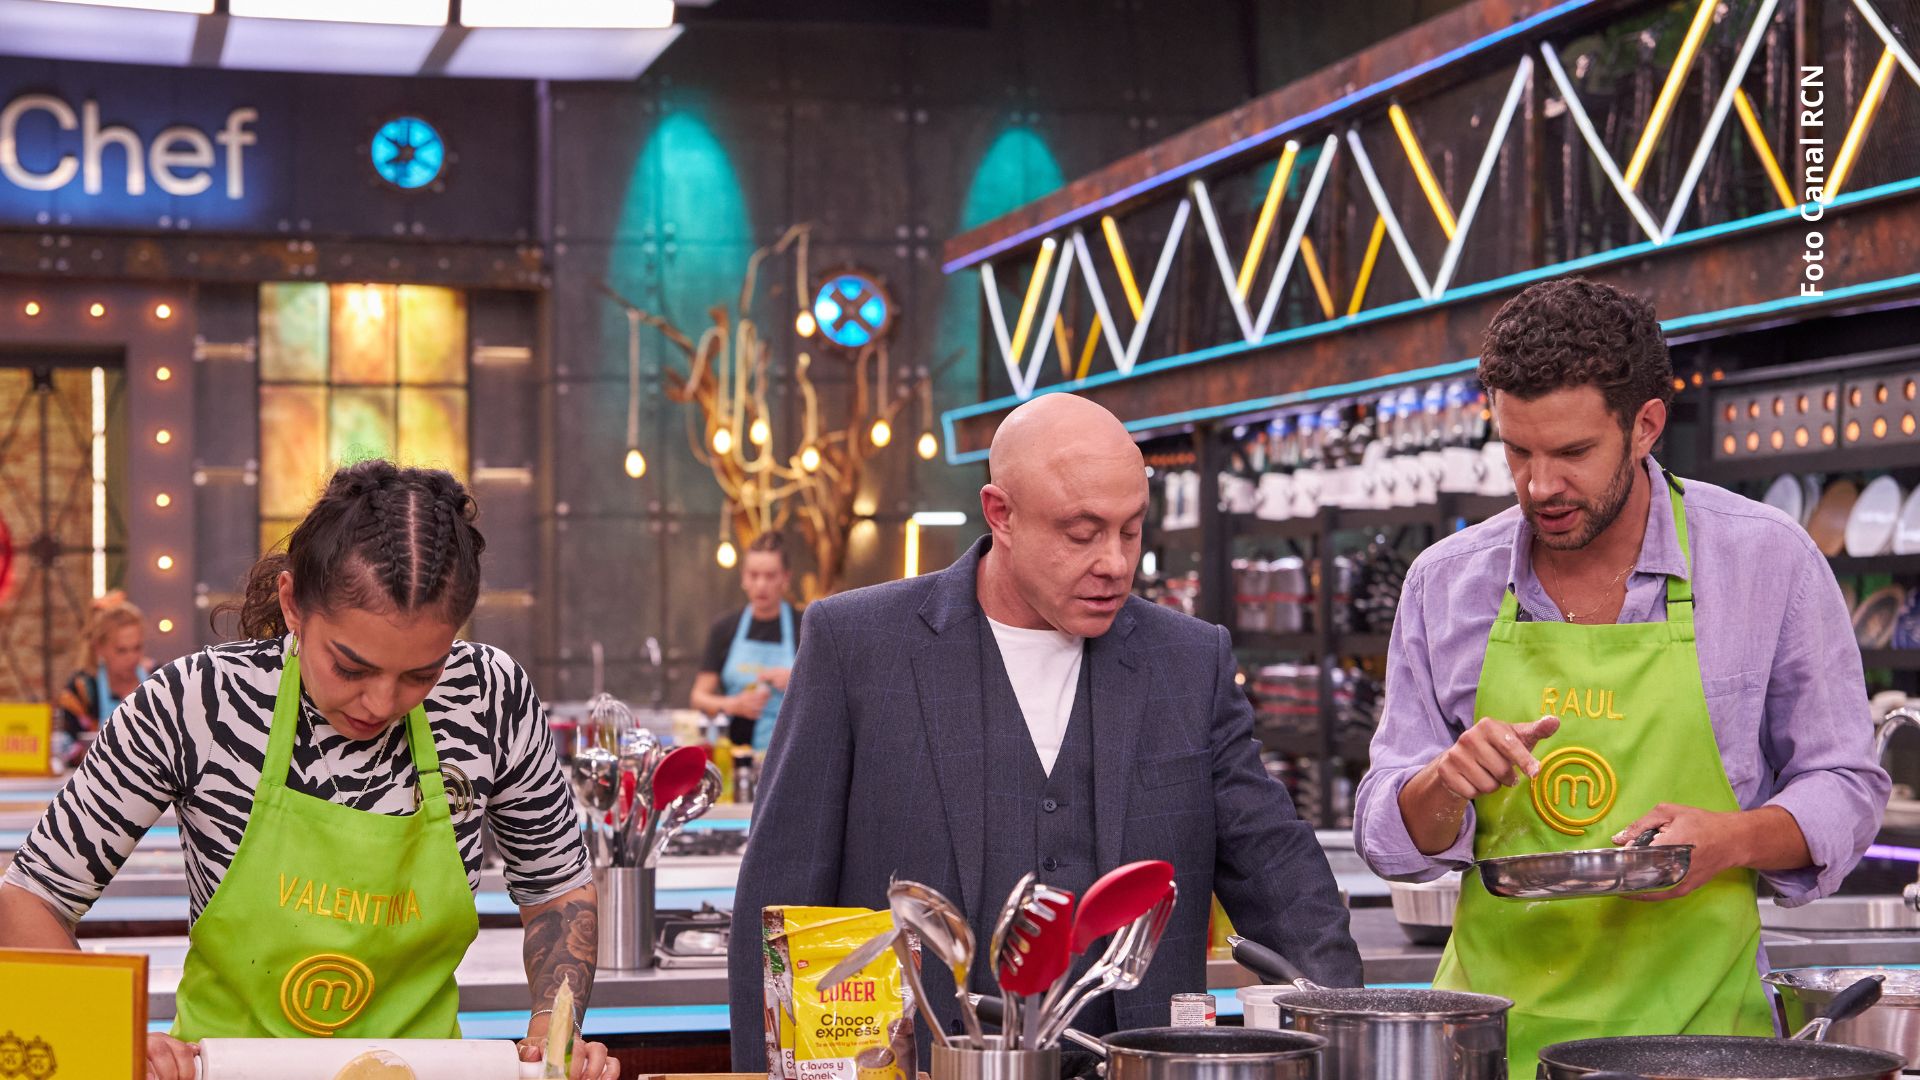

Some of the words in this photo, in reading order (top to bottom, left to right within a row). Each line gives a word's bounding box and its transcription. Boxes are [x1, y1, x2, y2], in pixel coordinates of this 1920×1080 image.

[0, 93, 259, 200] Chef
[1540, 687, 1624, 720] RAUL
[279, 872, 422, 927] VALENTINA
[819, 981, 876, 1003] LUKER
[821, 1013, 874, 1026] Choco
[815, 1025, 880, 1040] express
[837, 1061, 844, 1070] y
